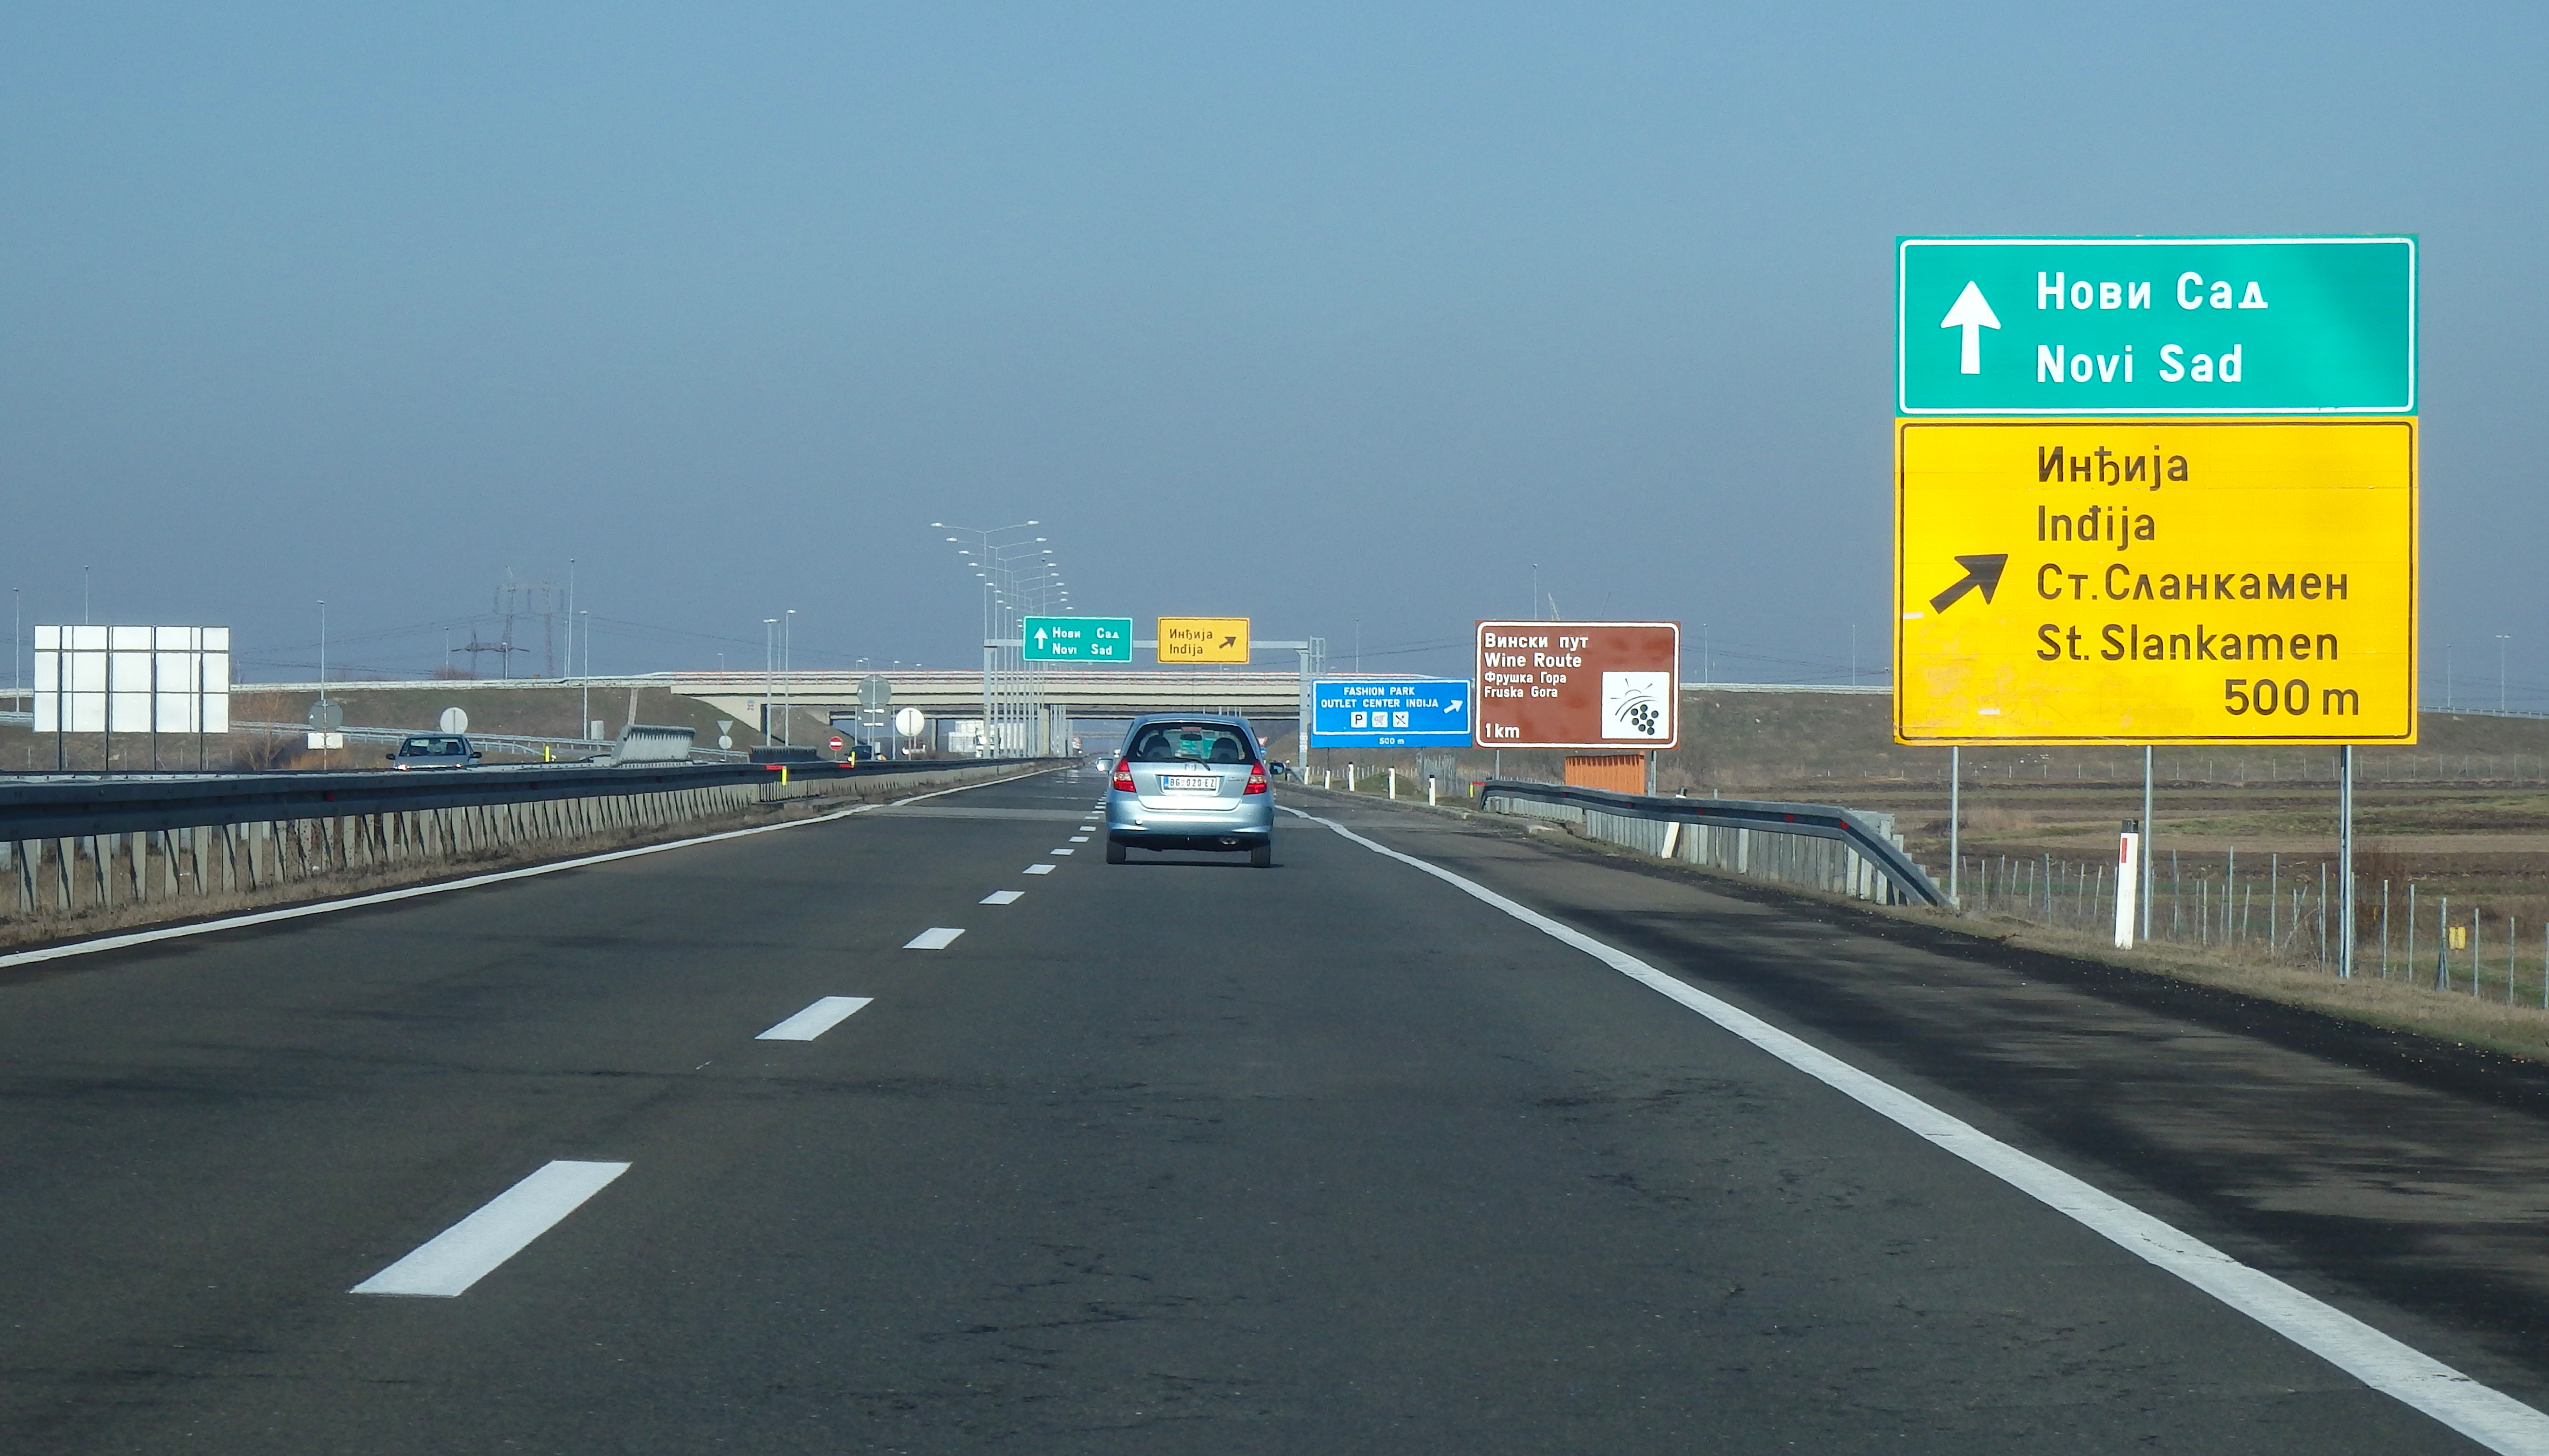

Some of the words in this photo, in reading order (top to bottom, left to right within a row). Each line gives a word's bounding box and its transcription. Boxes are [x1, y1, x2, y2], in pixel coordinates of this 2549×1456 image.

[2038, 271, 2150, 310] Нови
[2177, 271, 2268, 310] Сад
[2037, 344, 2133, 383] Novi
[2159, 344, 2242, 383] Sad
[2038, 445, 2188, 491] Инђија
[2038, 505, 2155, 551] Inđija
[1052, 626, 1081, 638] Нови
[1096, 627, 1119, 639] Сад
[1169, 628, 1213, 642] Инђија
[1485, 632, 1548, 648] Вински
[1559, 637, 1589, 651] пут
[1052, 643, 1077, 654] Novi
[1090, 643, 1112, 655] Sad
[1169, 643, 1203, 656] Inđija
[1484, 652, 1526, 667] Wine
[1533, 652, 1582, 668] Route
[1484, 671, 1533, 686] Фрушка
[1540, 671, 1566, 685] Гора
[1344, 687, 1385, 696] FASHION
[1390, 687, 1415, 696] PARK
[1484, 685, 1524, 698] Fruska
[1531, 685, 1558, 697] Gora
[2225, 679, 2309, 716] 500
[2323, 689, 2359, 716] m
[1321, 698, 1357, 708] OUTLET
[1363, 698, 1400, 708] CENTER
[1406, 698, 1439, 708] INDIJA
[1355, 714, 1363, 725] P
